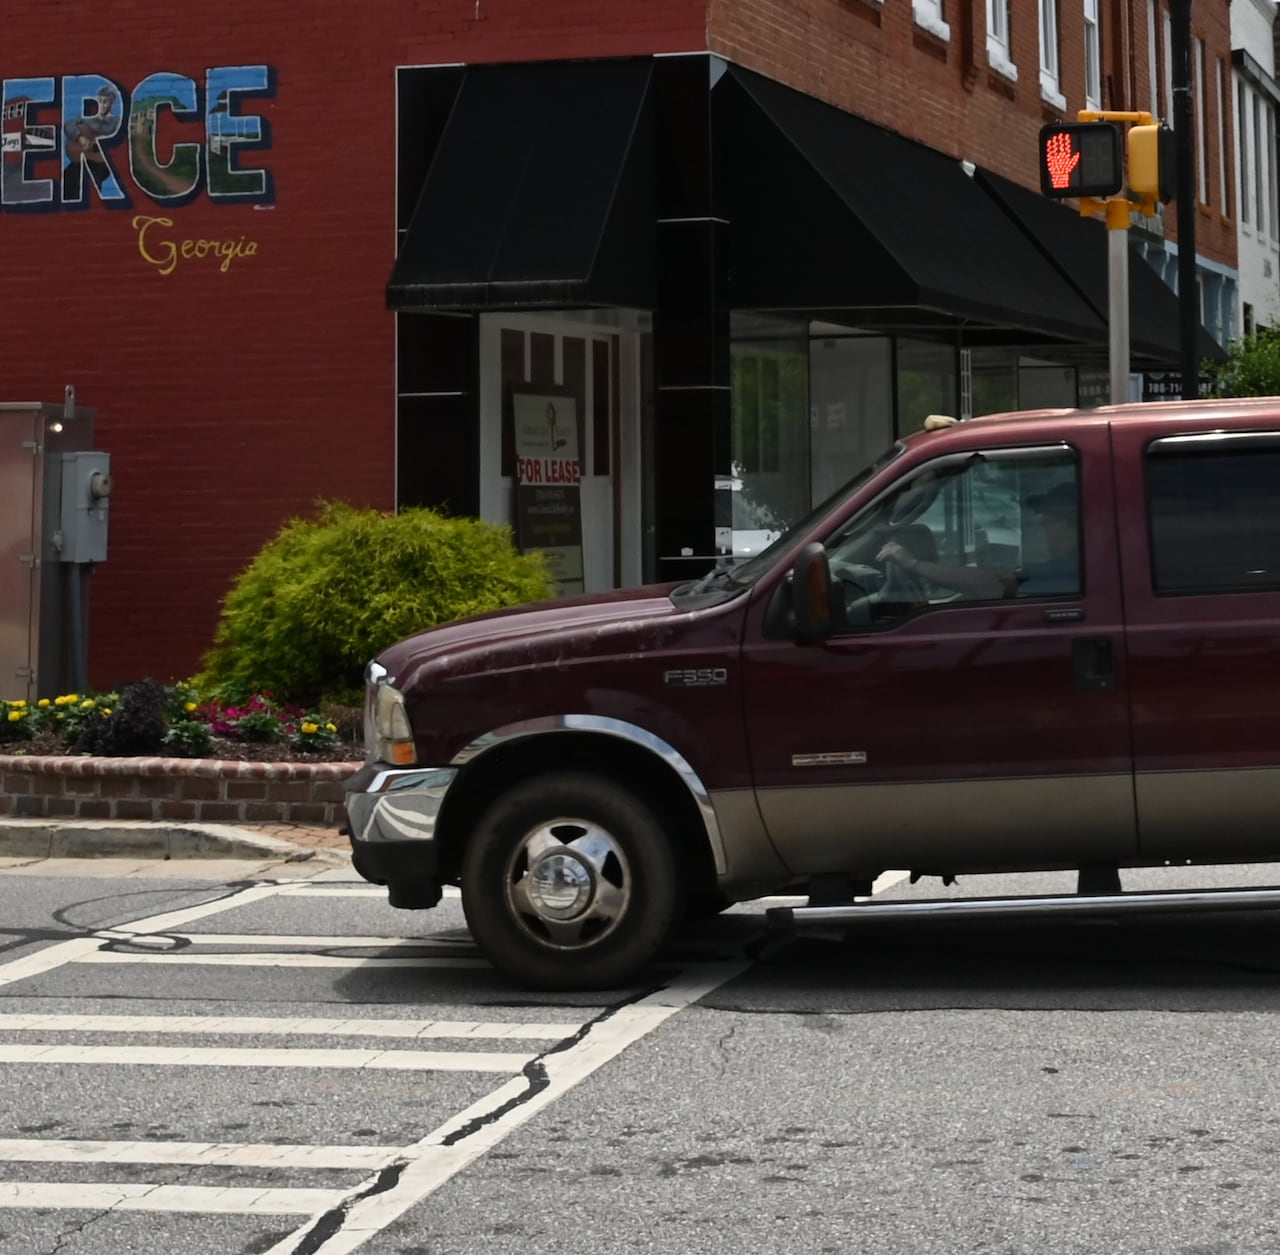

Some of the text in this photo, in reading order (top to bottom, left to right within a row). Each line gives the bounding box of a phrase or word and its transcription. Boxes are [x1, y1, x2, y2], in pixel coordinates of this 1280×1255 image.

[132, 215, 259, 276] Georgia
[519, 458, 580, 484] FOR LEASE
